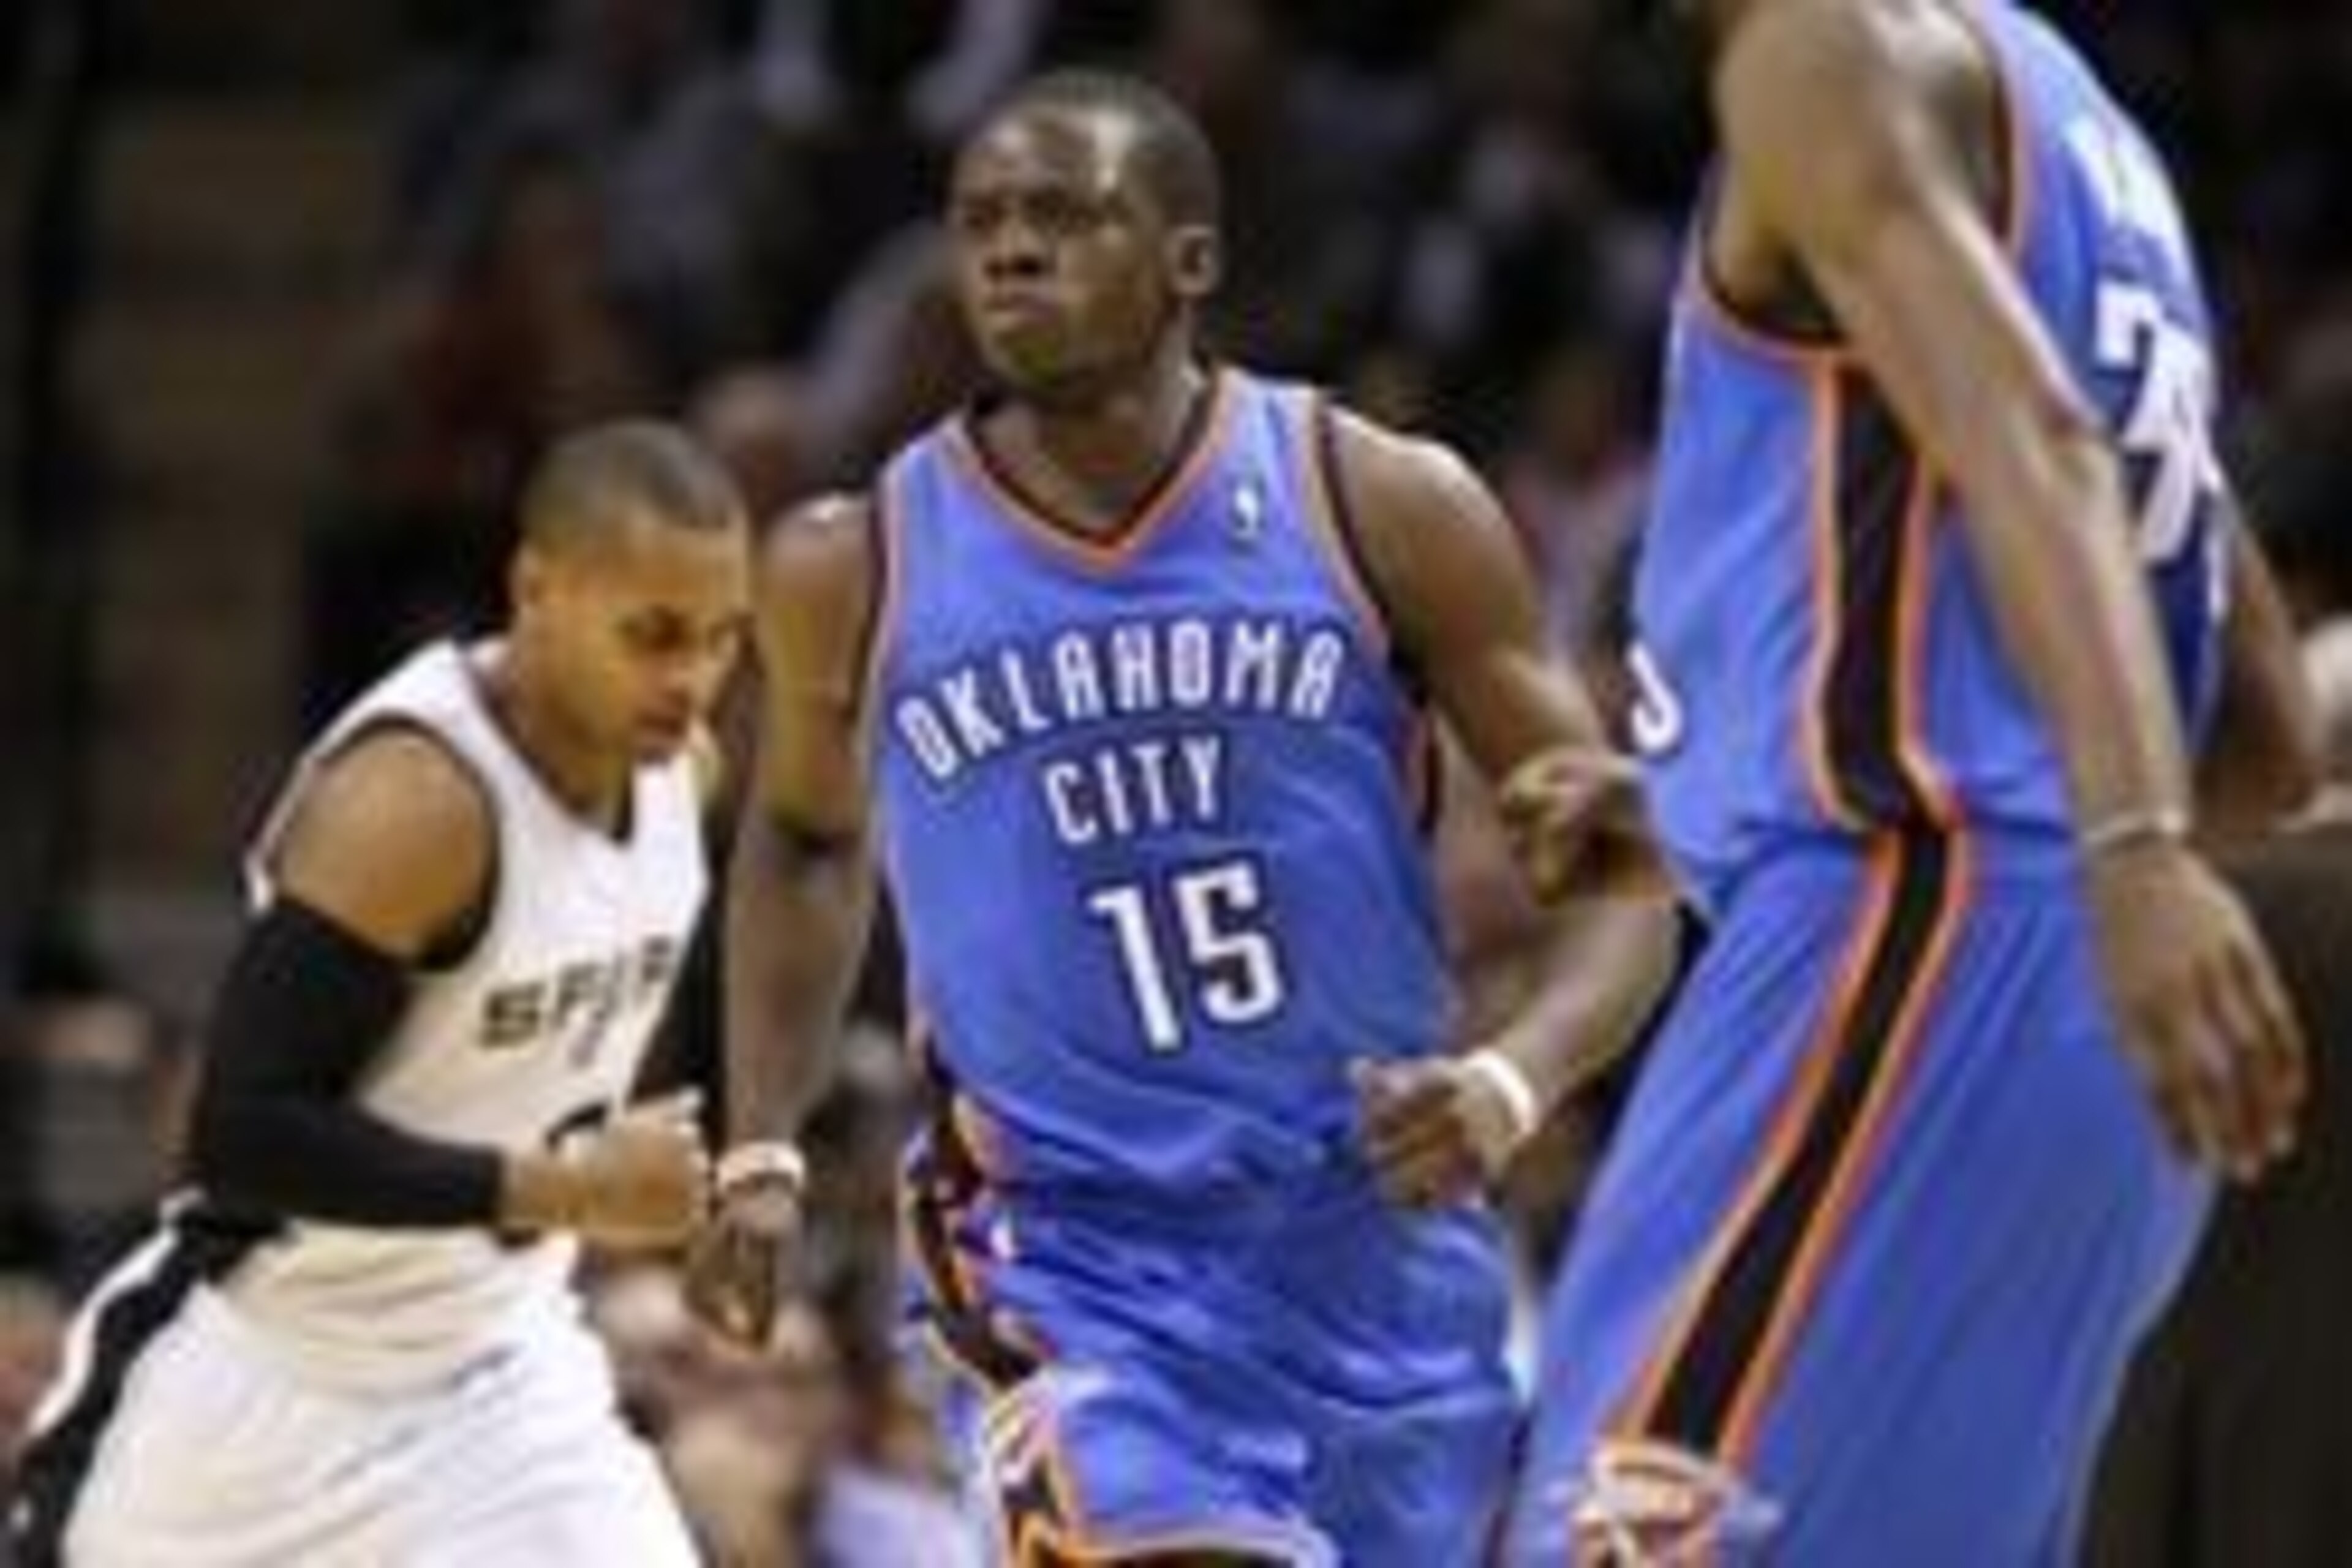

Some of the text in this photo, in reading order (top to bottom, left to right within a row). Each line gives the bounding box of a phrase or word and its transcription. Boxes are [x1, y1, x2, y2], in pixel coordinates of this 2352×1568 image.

[895, 619, 1344, 778] OKLAHOMA
[1045, 735, 1219, 843] CITY
[1088, 862, 1280, 1050] 15
